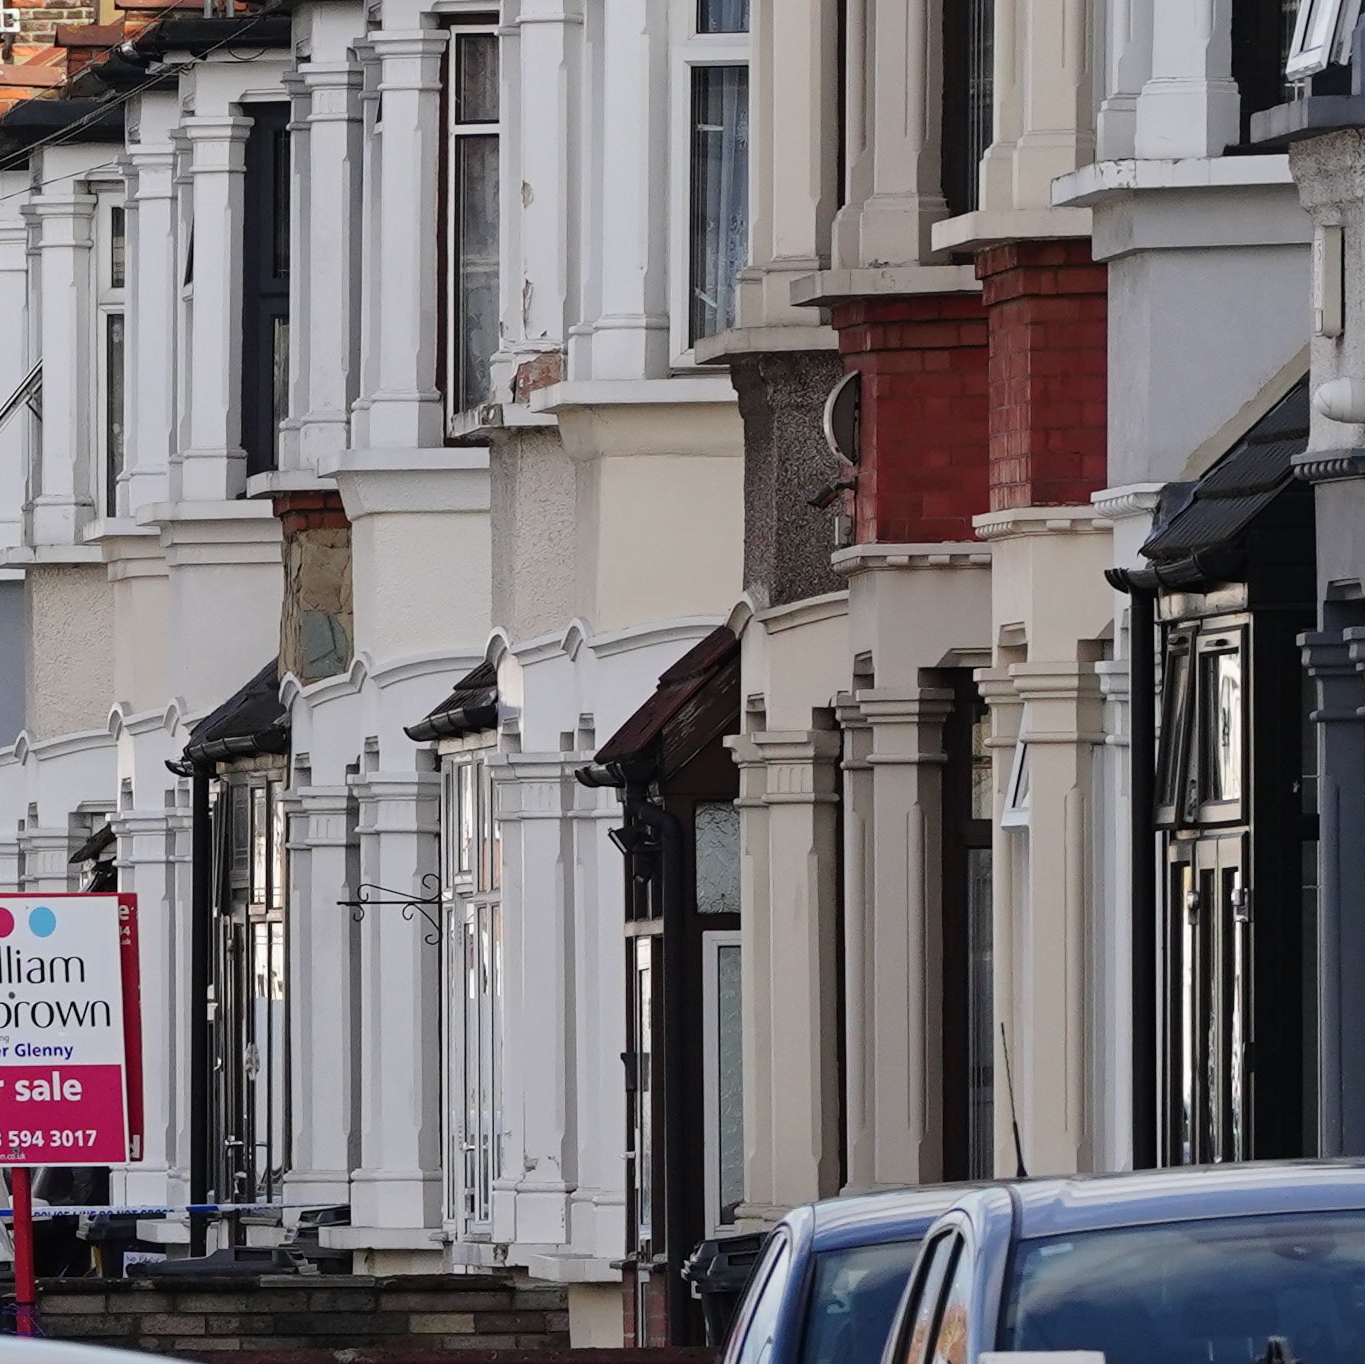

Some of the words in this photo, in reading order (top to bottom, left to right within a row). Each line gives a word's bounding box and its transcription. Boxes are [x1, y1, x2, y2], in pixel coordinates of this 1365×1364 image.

[14, 1043, 74, 1060] Glenny
[14, 1070, 82, 1102] sale
[7, 1129, 45, 1148] 594
[49, 1129, 97, 1147] 3017
